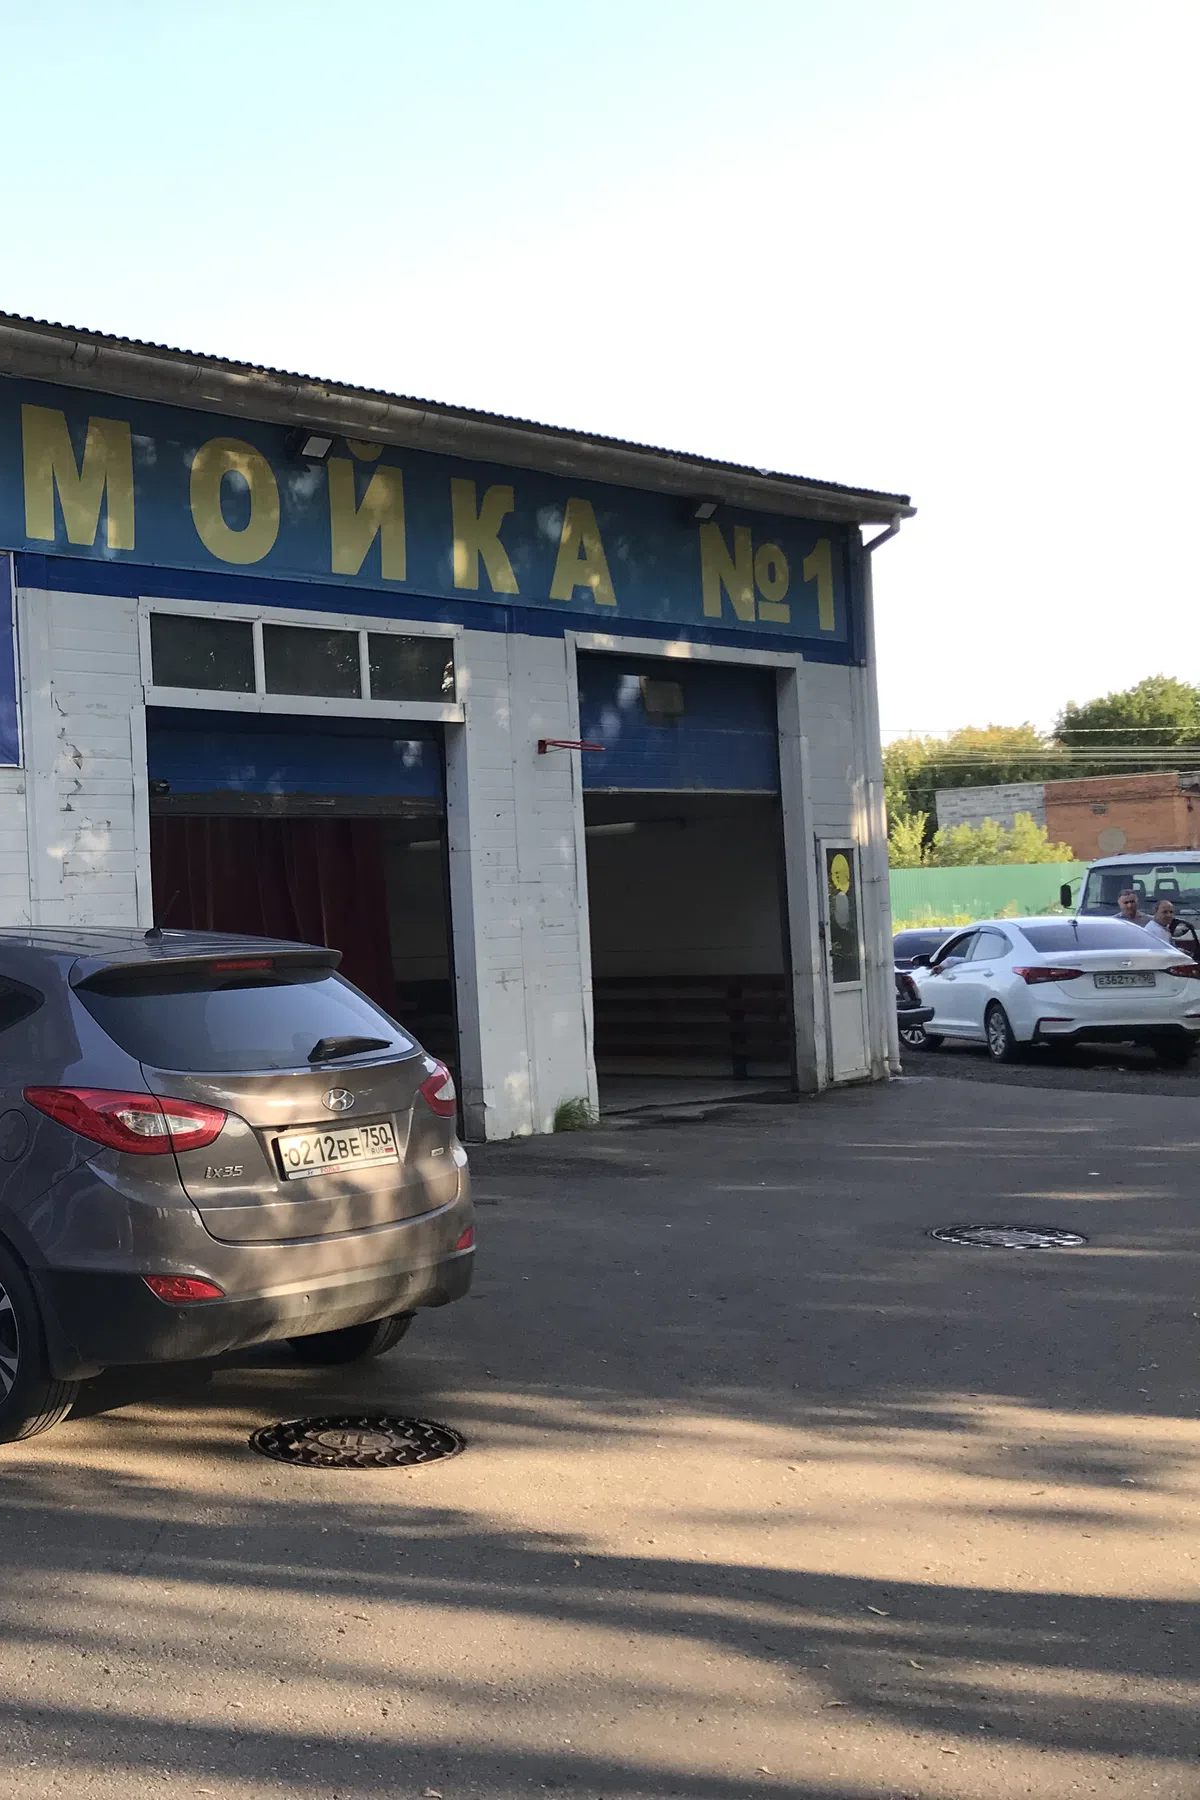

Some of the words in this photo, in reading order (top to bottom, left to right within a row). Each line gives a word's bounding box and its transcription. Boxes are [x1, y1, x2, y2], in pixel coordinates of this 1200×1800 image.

[700, 522, 835, 631] №1
[361, 1126, 389, 1148] 750
[204, 1165, 244, 1179] ix35
